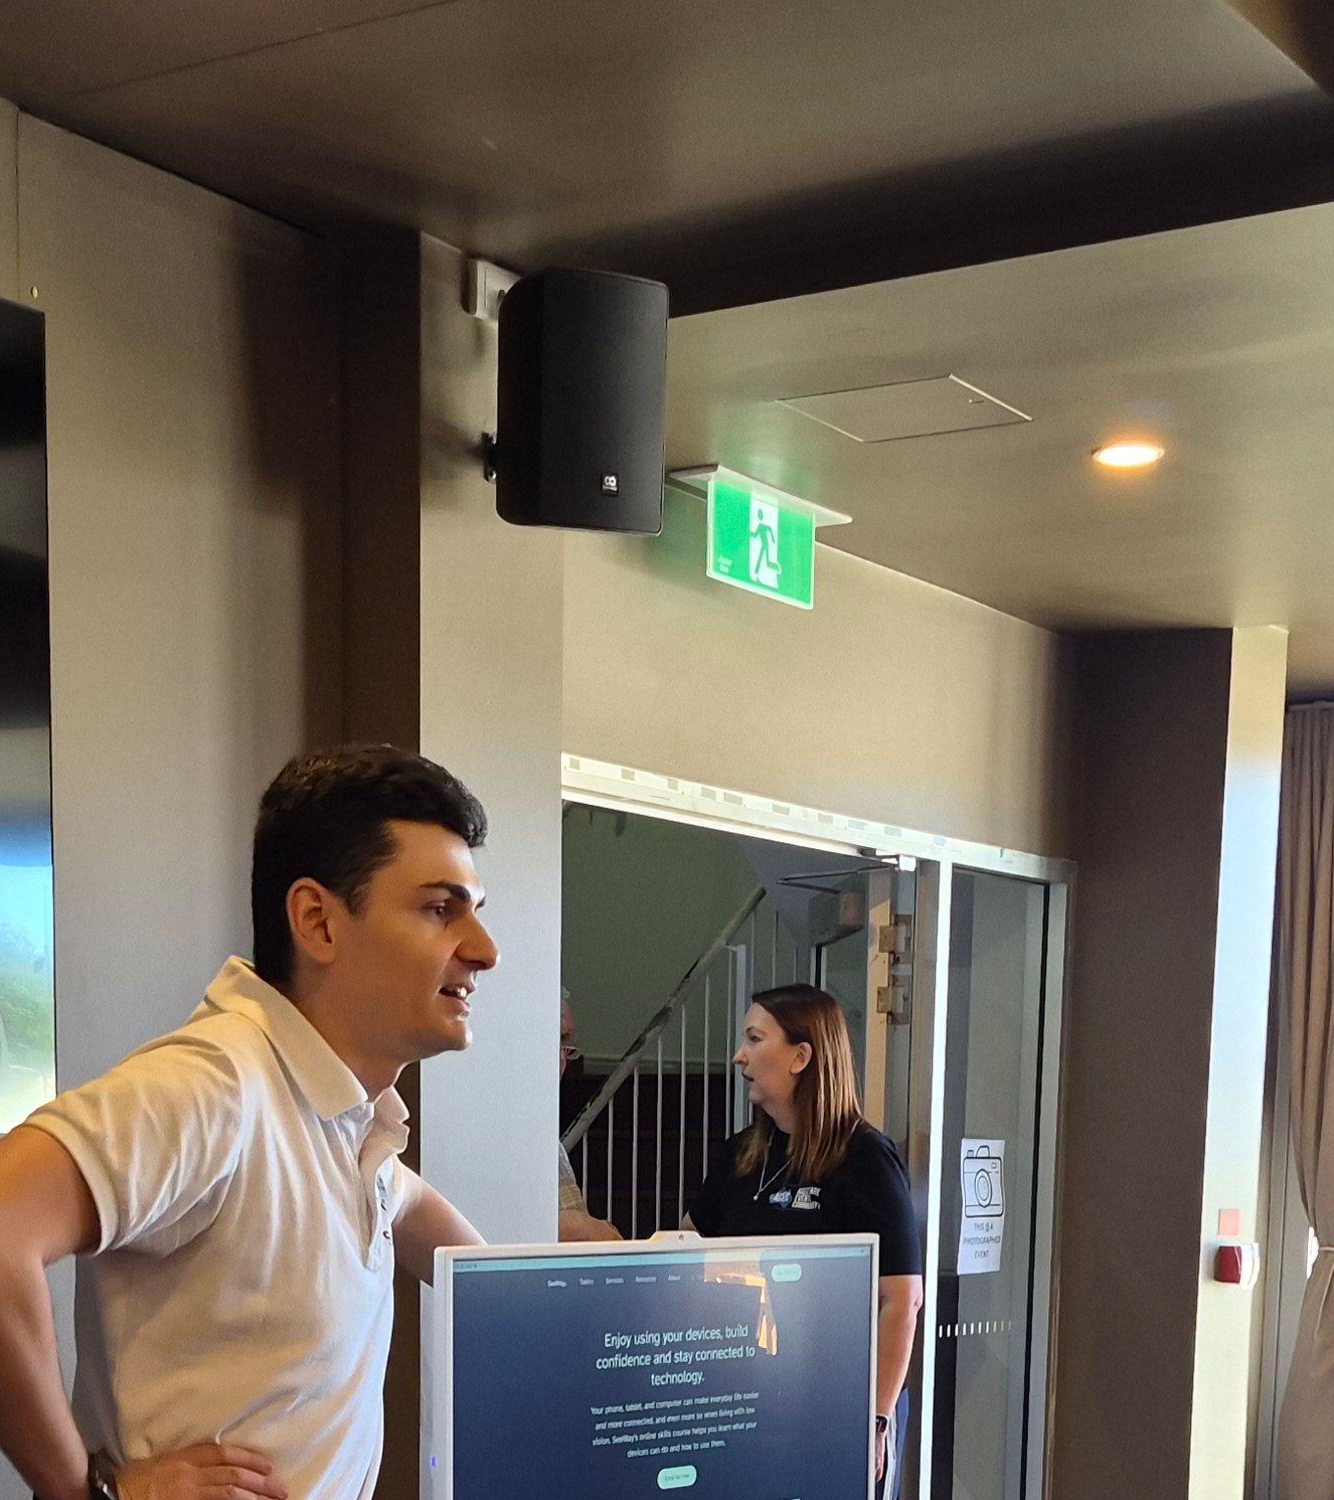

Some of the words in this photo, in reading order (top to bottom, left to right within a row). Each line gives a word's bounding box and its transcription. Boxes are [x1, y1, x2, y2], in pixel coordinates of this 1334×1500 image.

[604, 1332, 632, 1349] Enjoy
[633, 1330, 660, 1347] using
[662, 1330, 683, 1346] your
[685, 1326, 723, 1342] devices,
[725, 1324, 749, 1339] build
[595, 1353, 651, 1370] confidence
[653, 1350, 673, 1365] and
[674, 1350, 694, 1365] stay
[695, 1346, 745, 1362] connected
[745, 1345, 756, 1358] to
[650, 1370, 705, 1386] technology.
